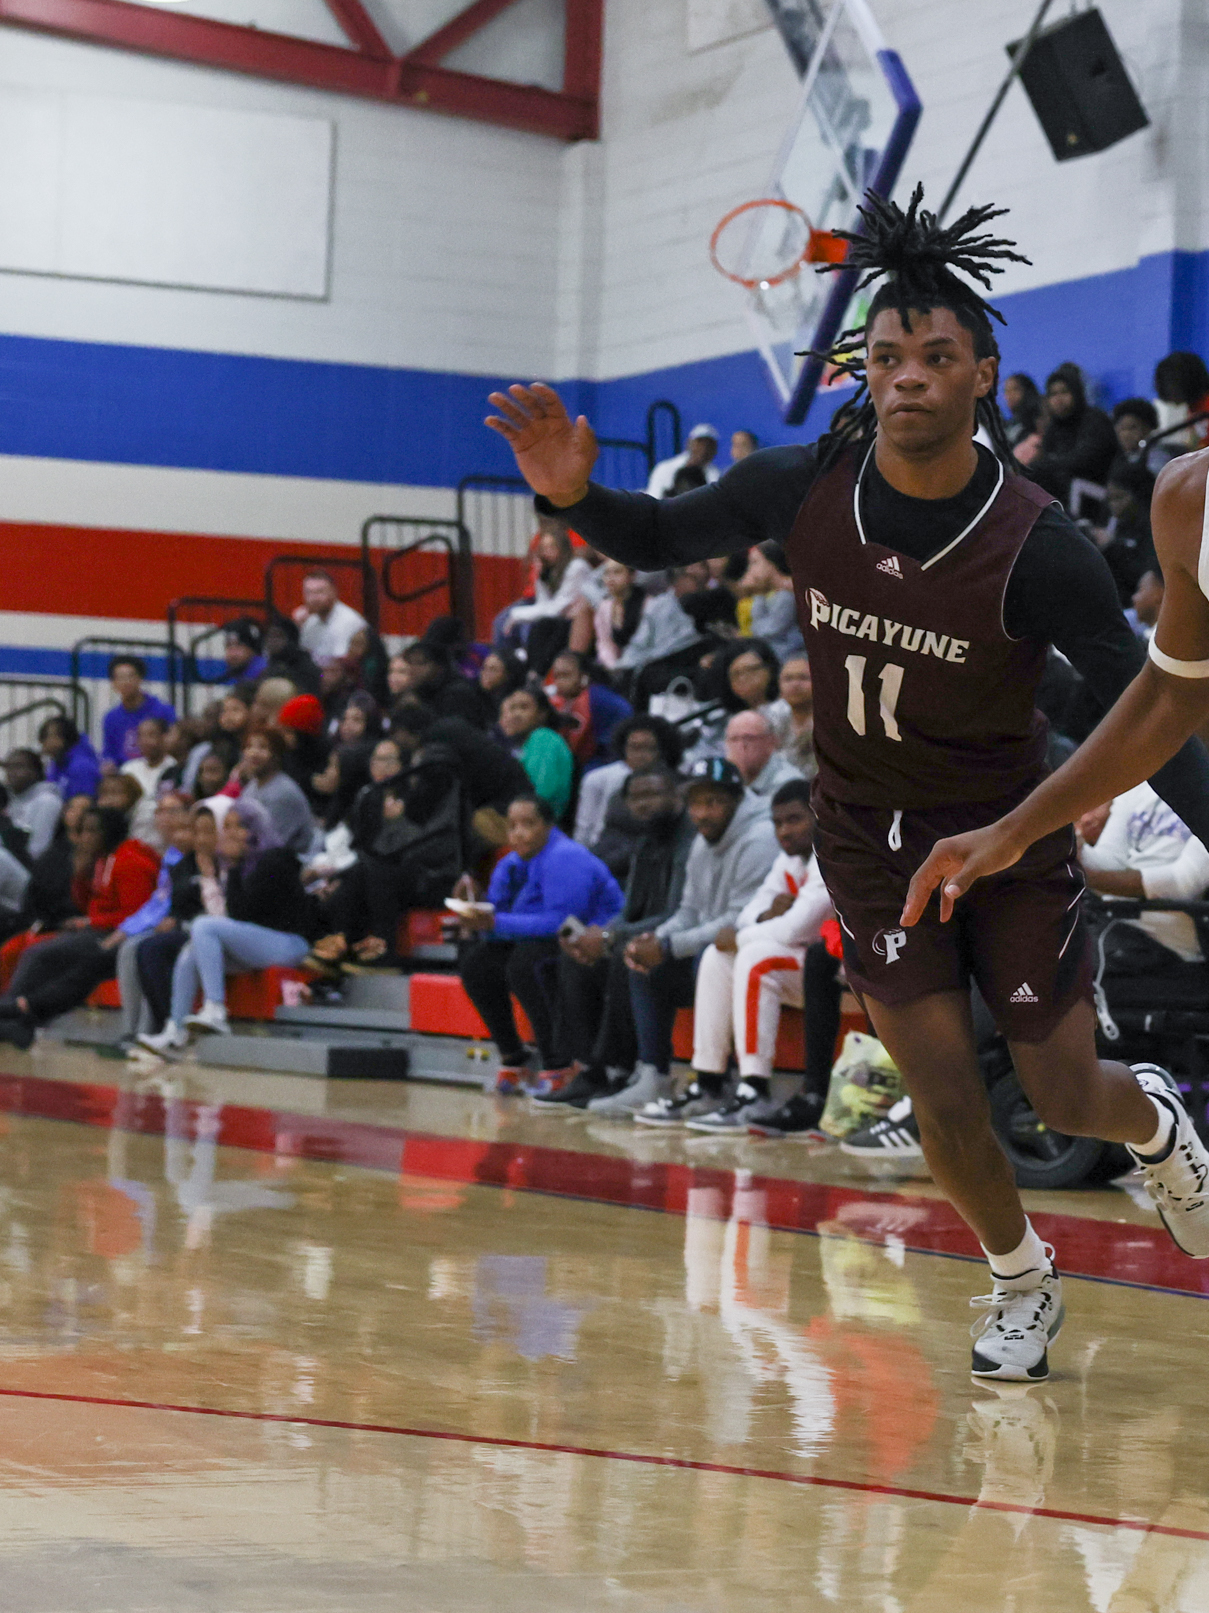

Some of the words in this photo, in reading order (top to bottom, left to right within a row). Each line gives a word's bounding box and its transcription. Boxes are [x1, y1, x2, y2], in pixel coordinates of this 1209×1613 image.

[876, 563, 904, 579] adidas
[809, 588, 970, 664] PICAYUNE
[844, 653, 905, 743] 11
[1009, 994, 1039, 1003] adidas
